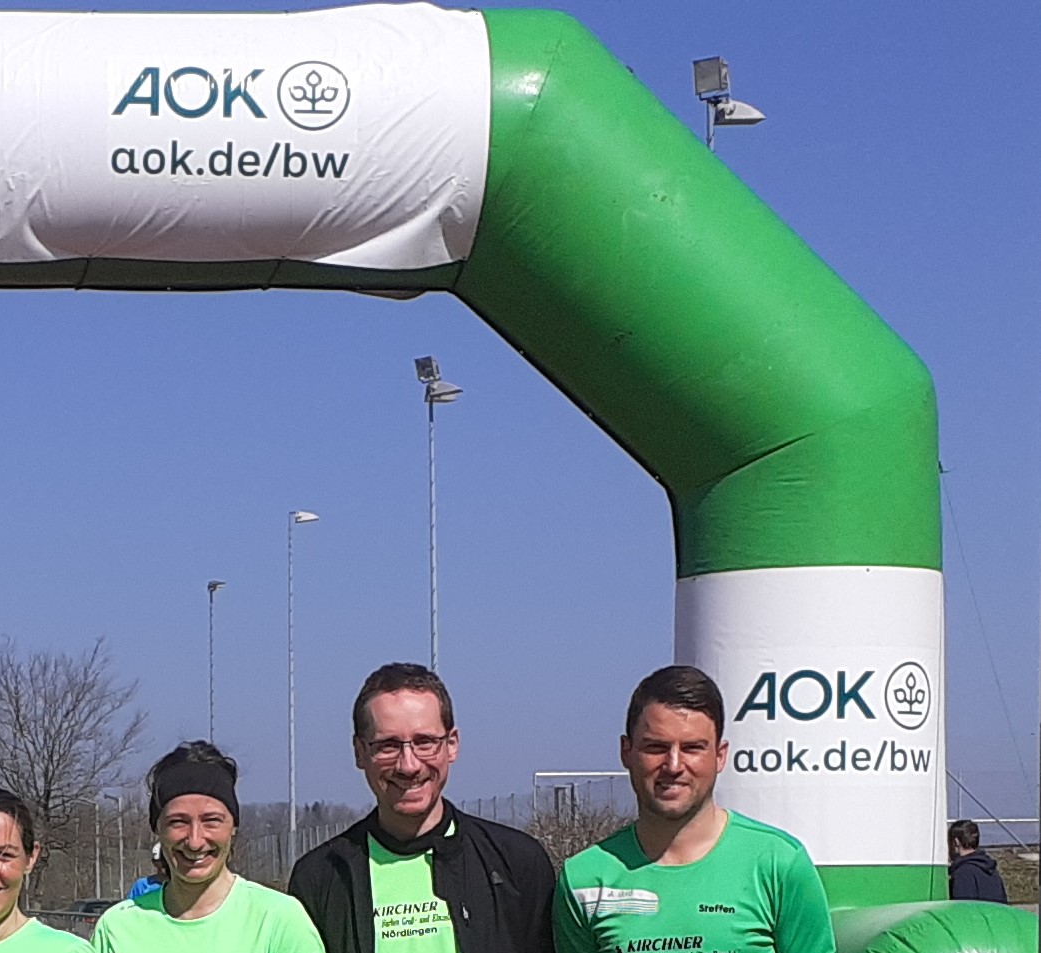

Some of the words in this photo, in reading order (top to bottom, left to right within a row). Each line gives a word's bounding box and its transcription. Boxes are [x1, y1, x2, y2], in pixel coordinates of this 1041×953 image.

[111, 66, 268, 119] AOK
[111, 140, 350, 178] aok.de/bw
[733, 669, 876, 721] AOK
[733, 740, 932, 773] aok.de/bw
[373, 901, 438, 917] KIRCHNER
[699, 903, 735, 914] Steffen
[381, 927, 438, 939] Nördlingen
[627, 936, 703, 952] KIRCHNER
